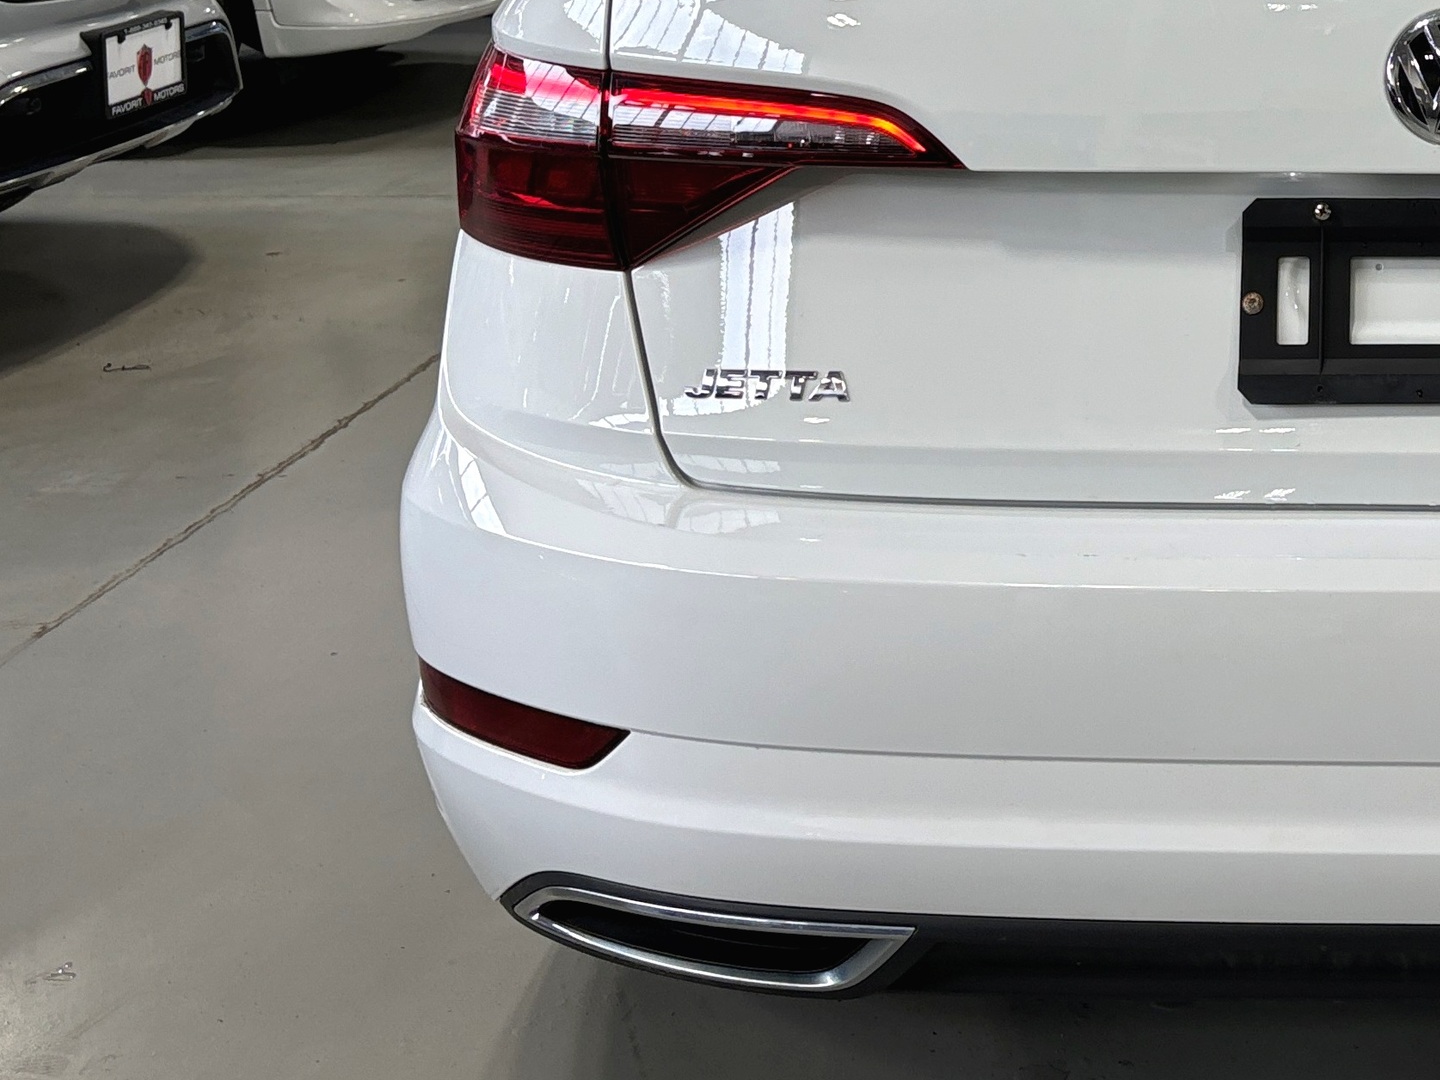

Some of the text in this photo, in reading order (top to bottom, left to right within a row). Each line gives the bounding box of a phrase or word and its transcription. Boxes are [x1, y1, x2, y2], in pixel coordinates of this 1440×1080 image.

[107, 64, 135, 80] AVORIT
[111, 83, 185, 116] FAVORIT MOTORS
[683, 368, 850, 402] JETTA
